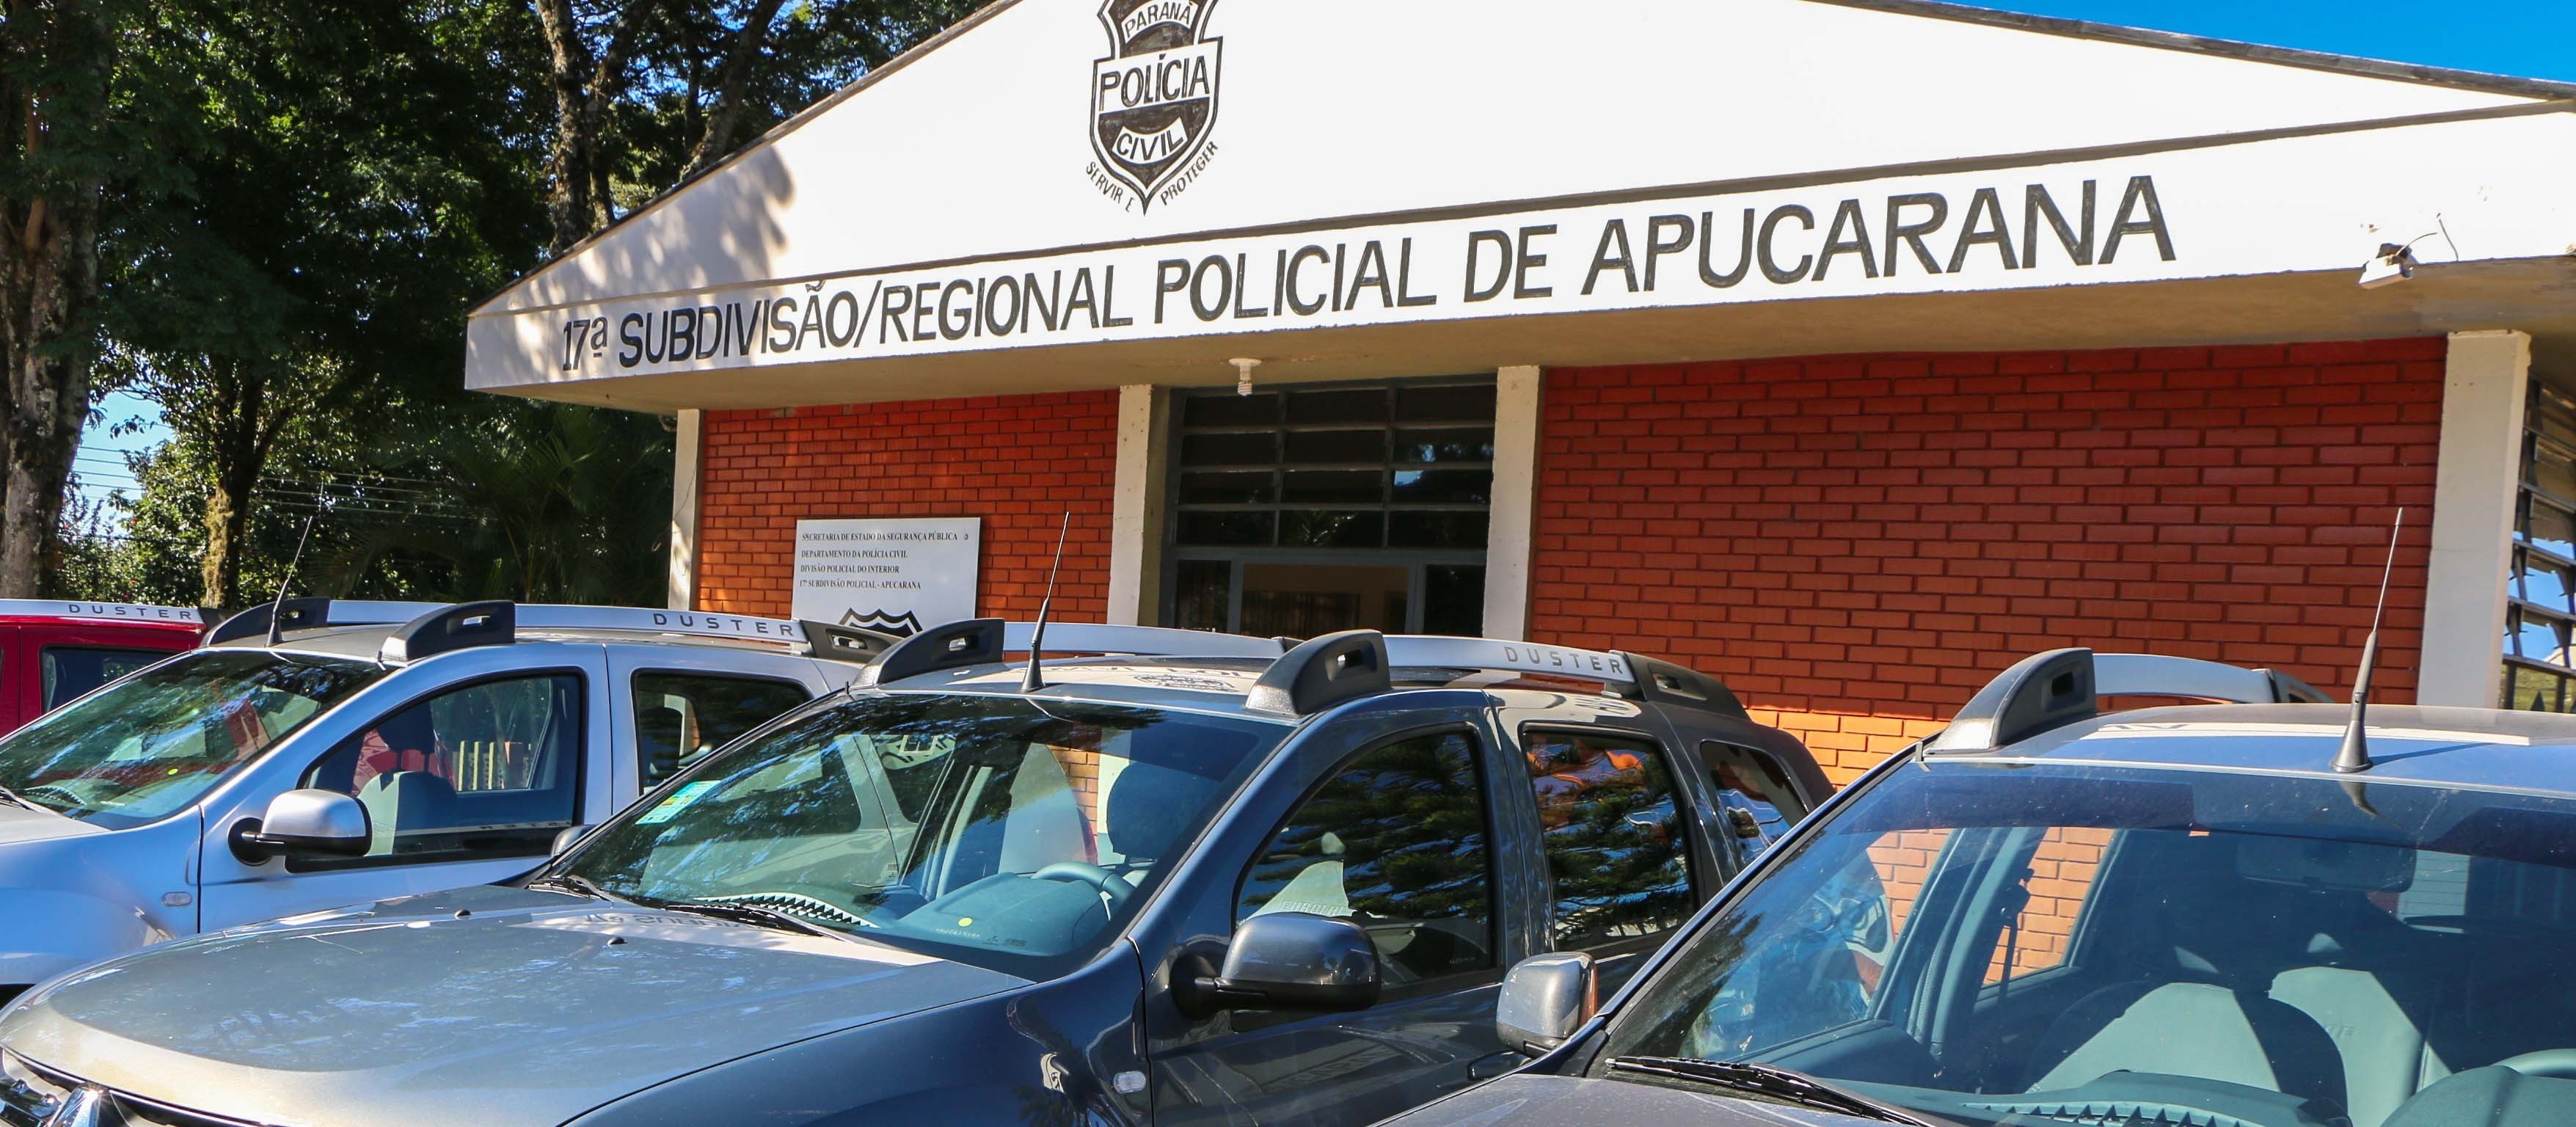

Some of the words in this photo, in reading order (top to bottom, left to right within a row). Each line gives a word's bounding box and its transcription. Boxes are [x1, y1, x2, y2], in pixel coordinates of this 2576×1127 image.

[1124, 1, 1194, 38] PARANÁ
[1099, 54, 1210, 112] POLÍCIA
[1117, 130, 1183, 160] CIVIL
[1086, 161, 1123, 204] SERVIR
[1125, 197, 1136, 213] E
[1160, 141, 1219, 205] PROTEGER
[1155, 237, 1437, 324] POLICIAL
[1464, 224, 1558, 303] DE
[1580, 175, 2177, 296] APUCARANA
[841, 533, 850, 541] DE
[851, 533, 876, 541] ESTADO
[877, 533, 886, 541] DA
[886, 533, 927, 542] SEGURANÇA
[928, 530, 957, 541] PÚBLICA
[801, 550, 851, 558] DEPARTAMENTO
[852, 550, 861, 558] DA
[862, 547, 889, 558] POLÍCIA
[889, 550, 908, 558] CIVIL
[800, 563, 826, 573] DIVISÃO
[827, 565, 856, 573] POLICIAL
[857, 565, 867, 573] DO
[868, 565, 900, 573] INTERIOR
[808, 578, 845, 588] SUBDIVISÃO
[846, 580, 876, 588] POLICIAL
[880, 580, 922, 589] APUCARANA
[69, 604, 191, 620] DUSTER
[653, 613, 794, 637] DUSTER
[1504, 646, 1623, 674] DUSTER
